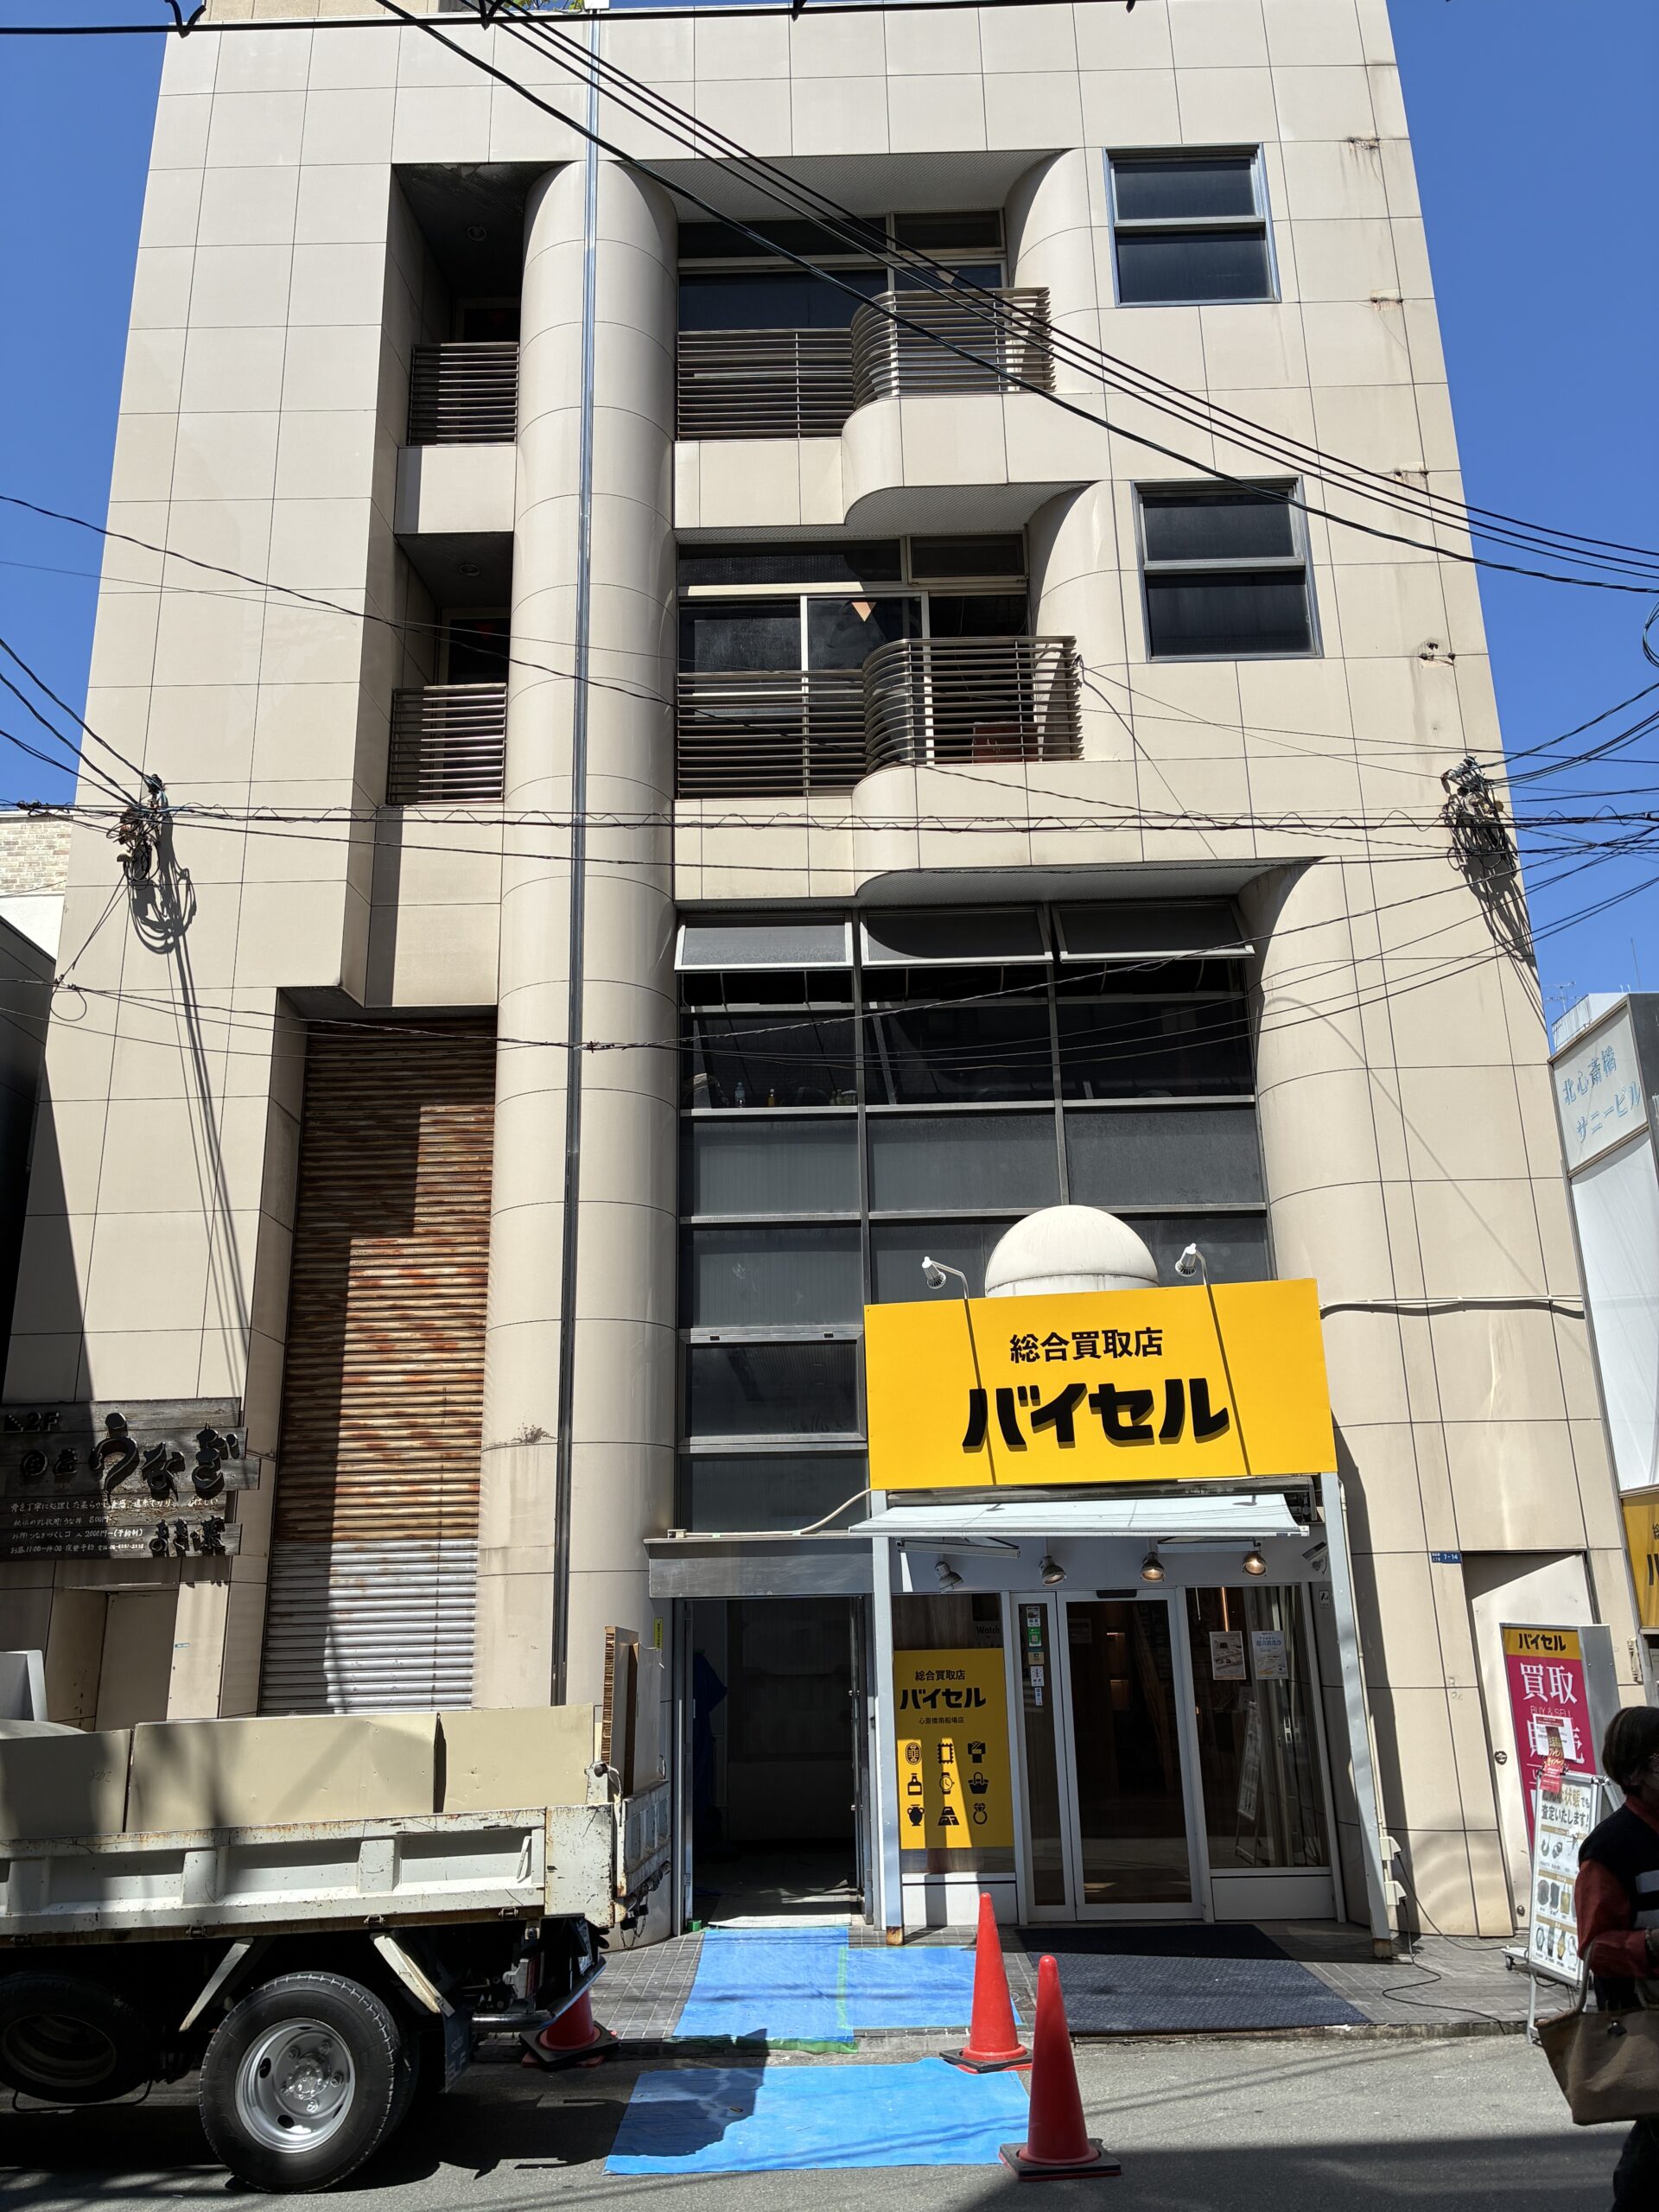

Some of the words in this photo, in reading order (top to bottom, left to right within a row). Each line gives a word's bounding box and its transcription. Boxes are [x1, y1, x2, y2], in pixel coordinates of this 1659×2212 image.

[1576, 1081, 1641, 1143] サニービル
[1010, 1327, 1163, 1363] 総合買取店
[962, 1378, 1230, 1451] バイセル
[1519, 1633, 1566, 1651] バイセル
[915, 1669, 965, 1681] 総合買取店
[1520, 1662, 1577, 1704] 買取
[899, 1688, 986, 1709] バイセル
[1541, 1804, 1589, 1827] 査定いたします!
